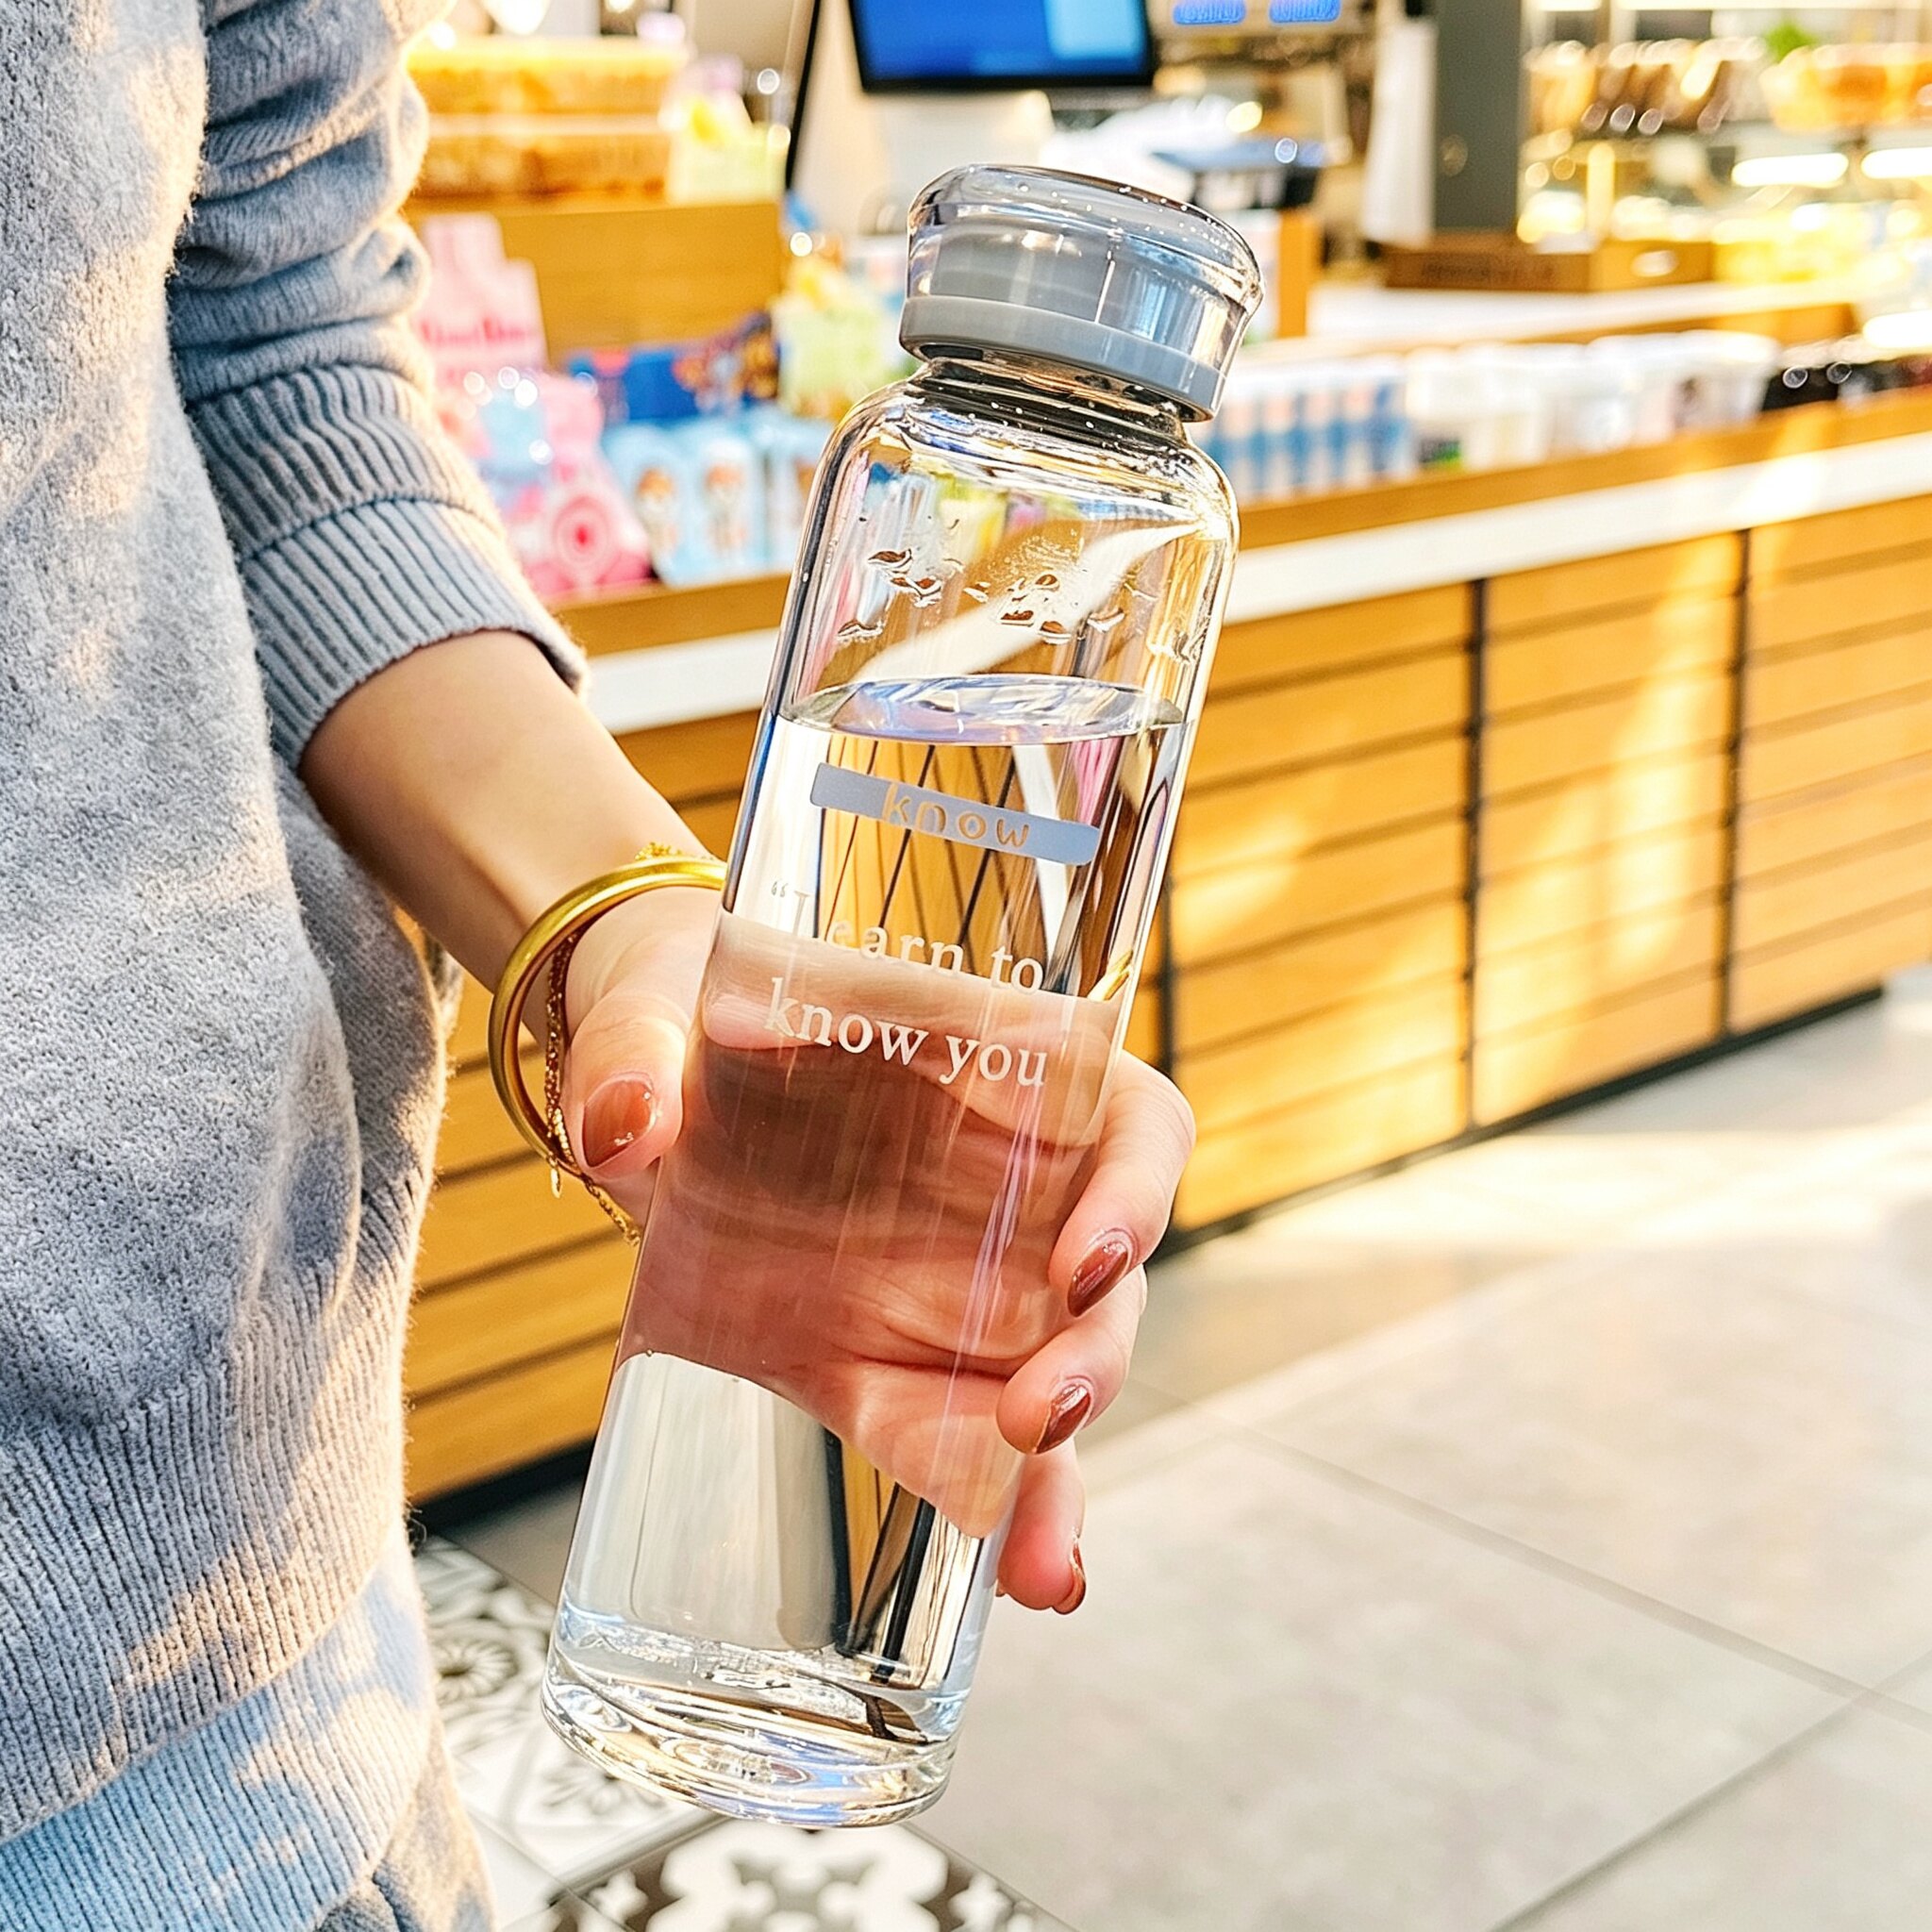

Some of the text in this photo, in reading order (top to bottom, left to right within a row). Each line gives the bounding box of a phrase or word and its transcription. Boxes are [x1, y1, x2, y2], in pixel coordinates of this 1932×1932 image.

[881, 781, 1029, 848] know
[991, 944, 1044, 994] to
[764, 977, 1048, 1086] know you
